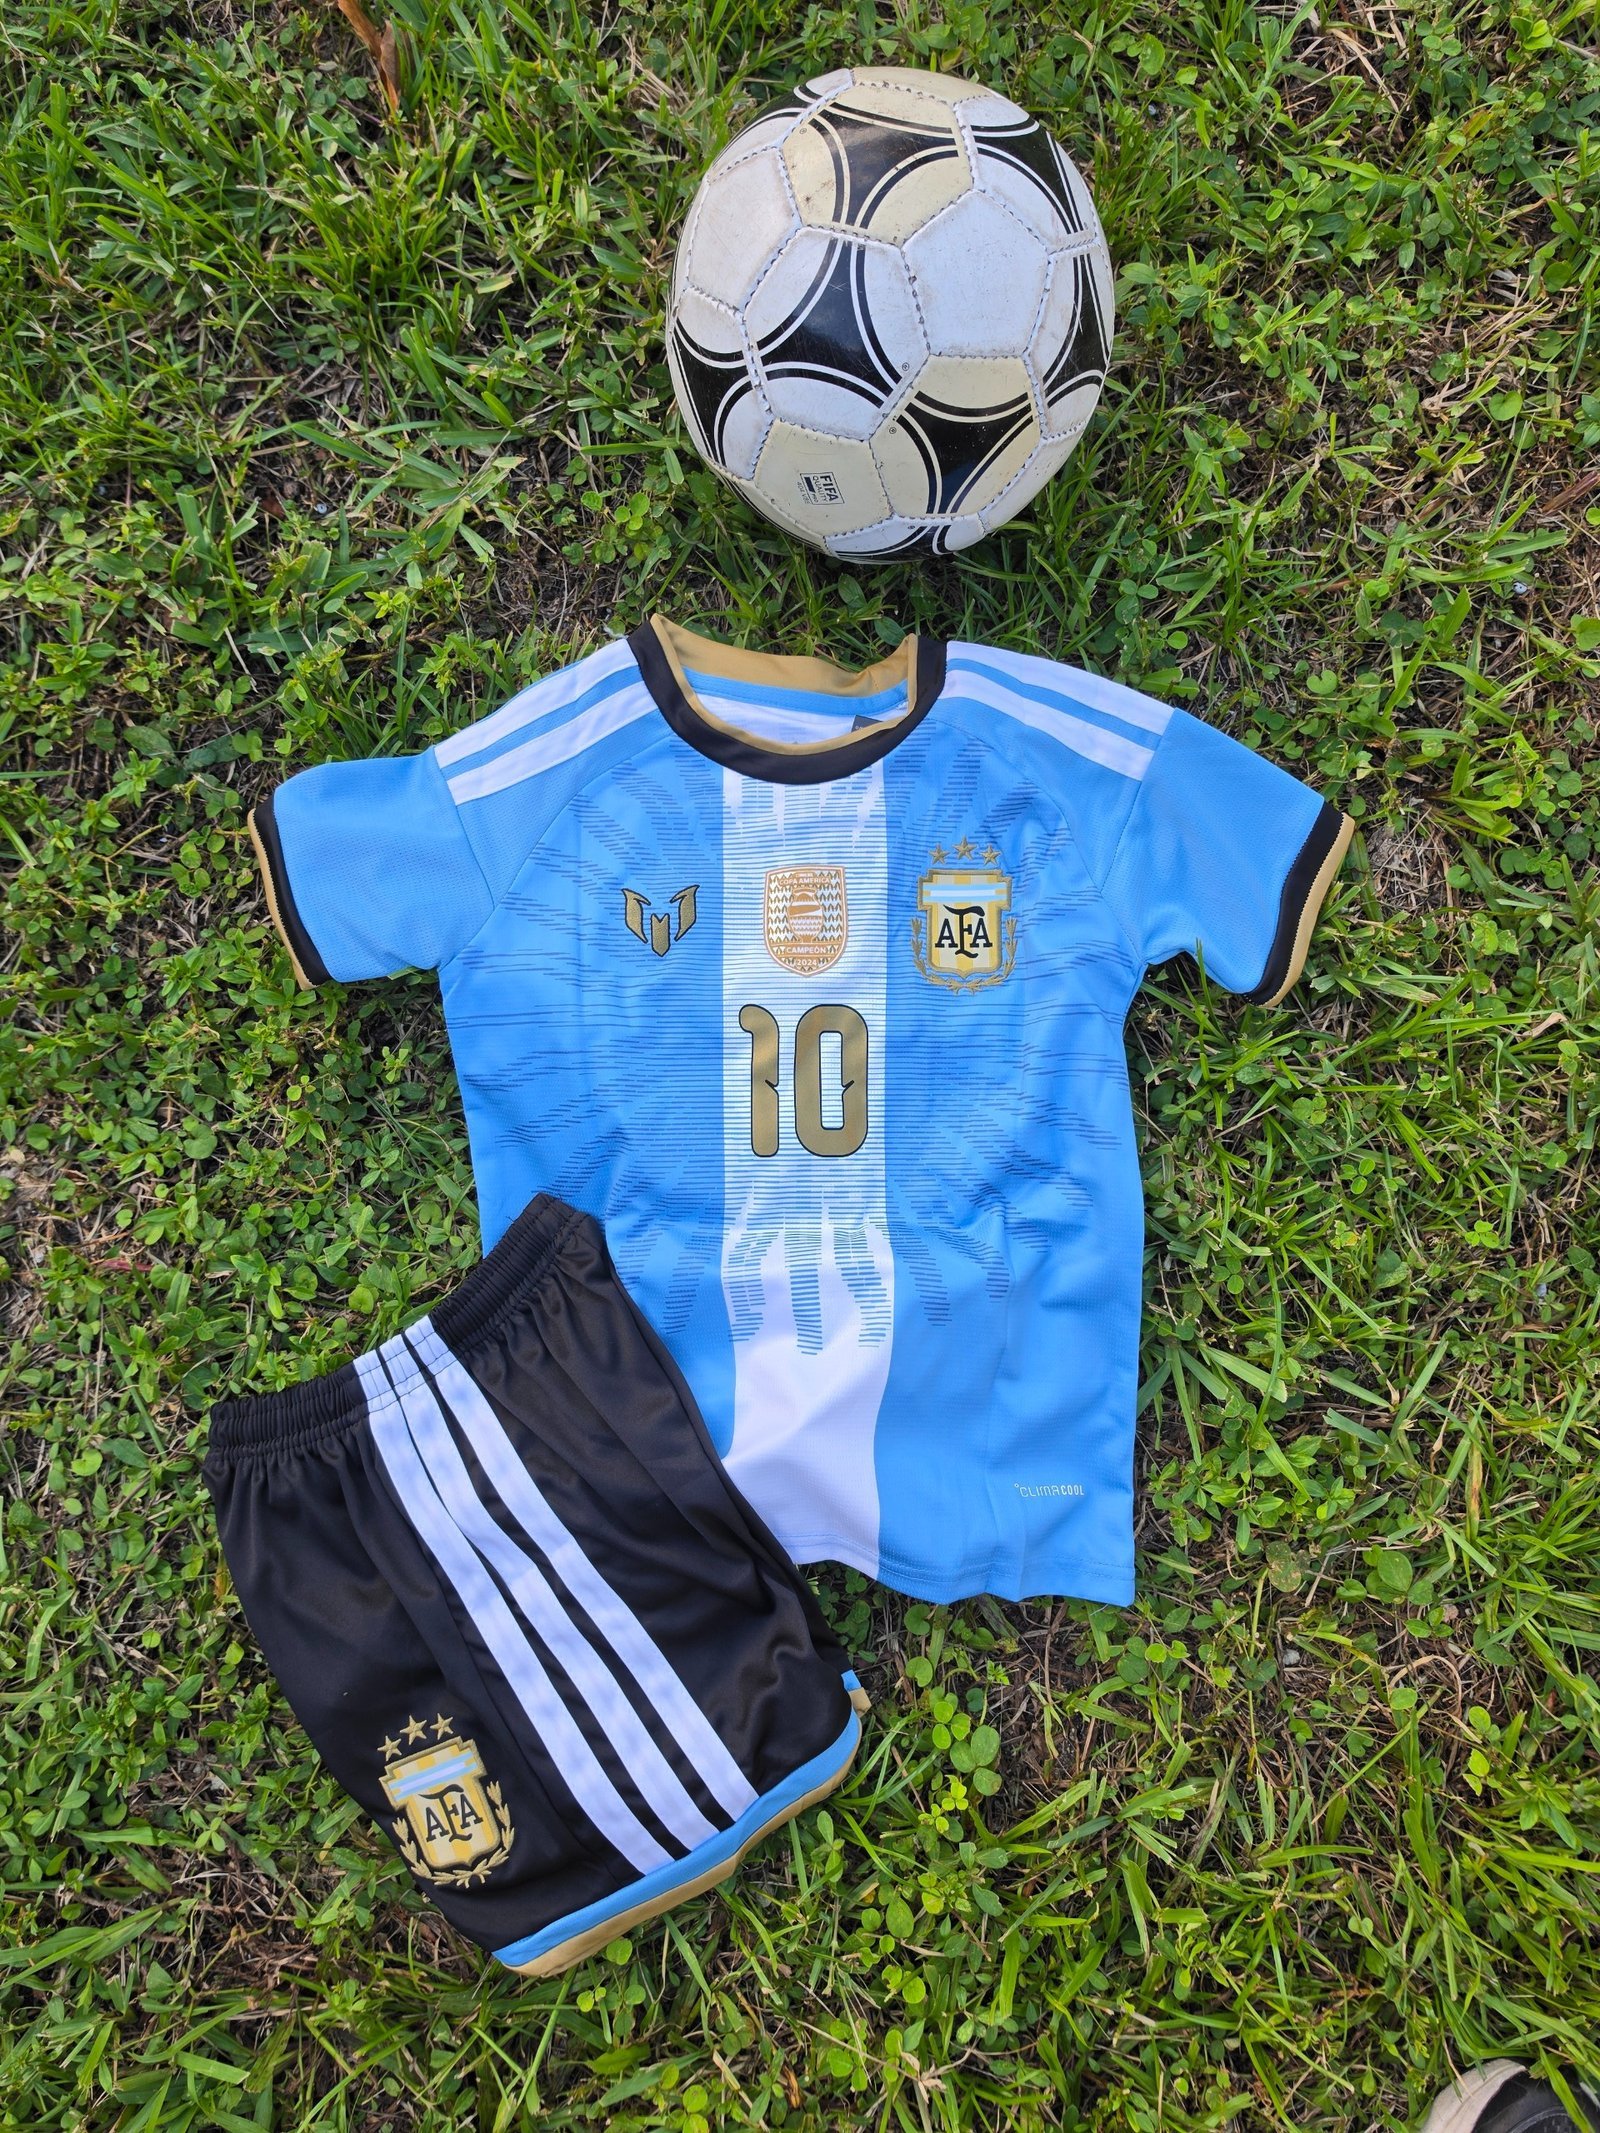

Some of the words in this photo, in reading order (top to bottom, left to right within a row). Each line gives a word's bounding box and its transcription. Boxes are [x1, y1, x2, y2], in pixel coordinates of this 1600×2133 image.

[813, 475, 828, 502] QUALITY
[820, 475, 839, 501] FIFA
[779, 878, 798, 886] COPA
[935, 904, 993, 959] AFA
[738, 1003, 869, 1158] 10
[417, 1783, 484, 1843] AFA
